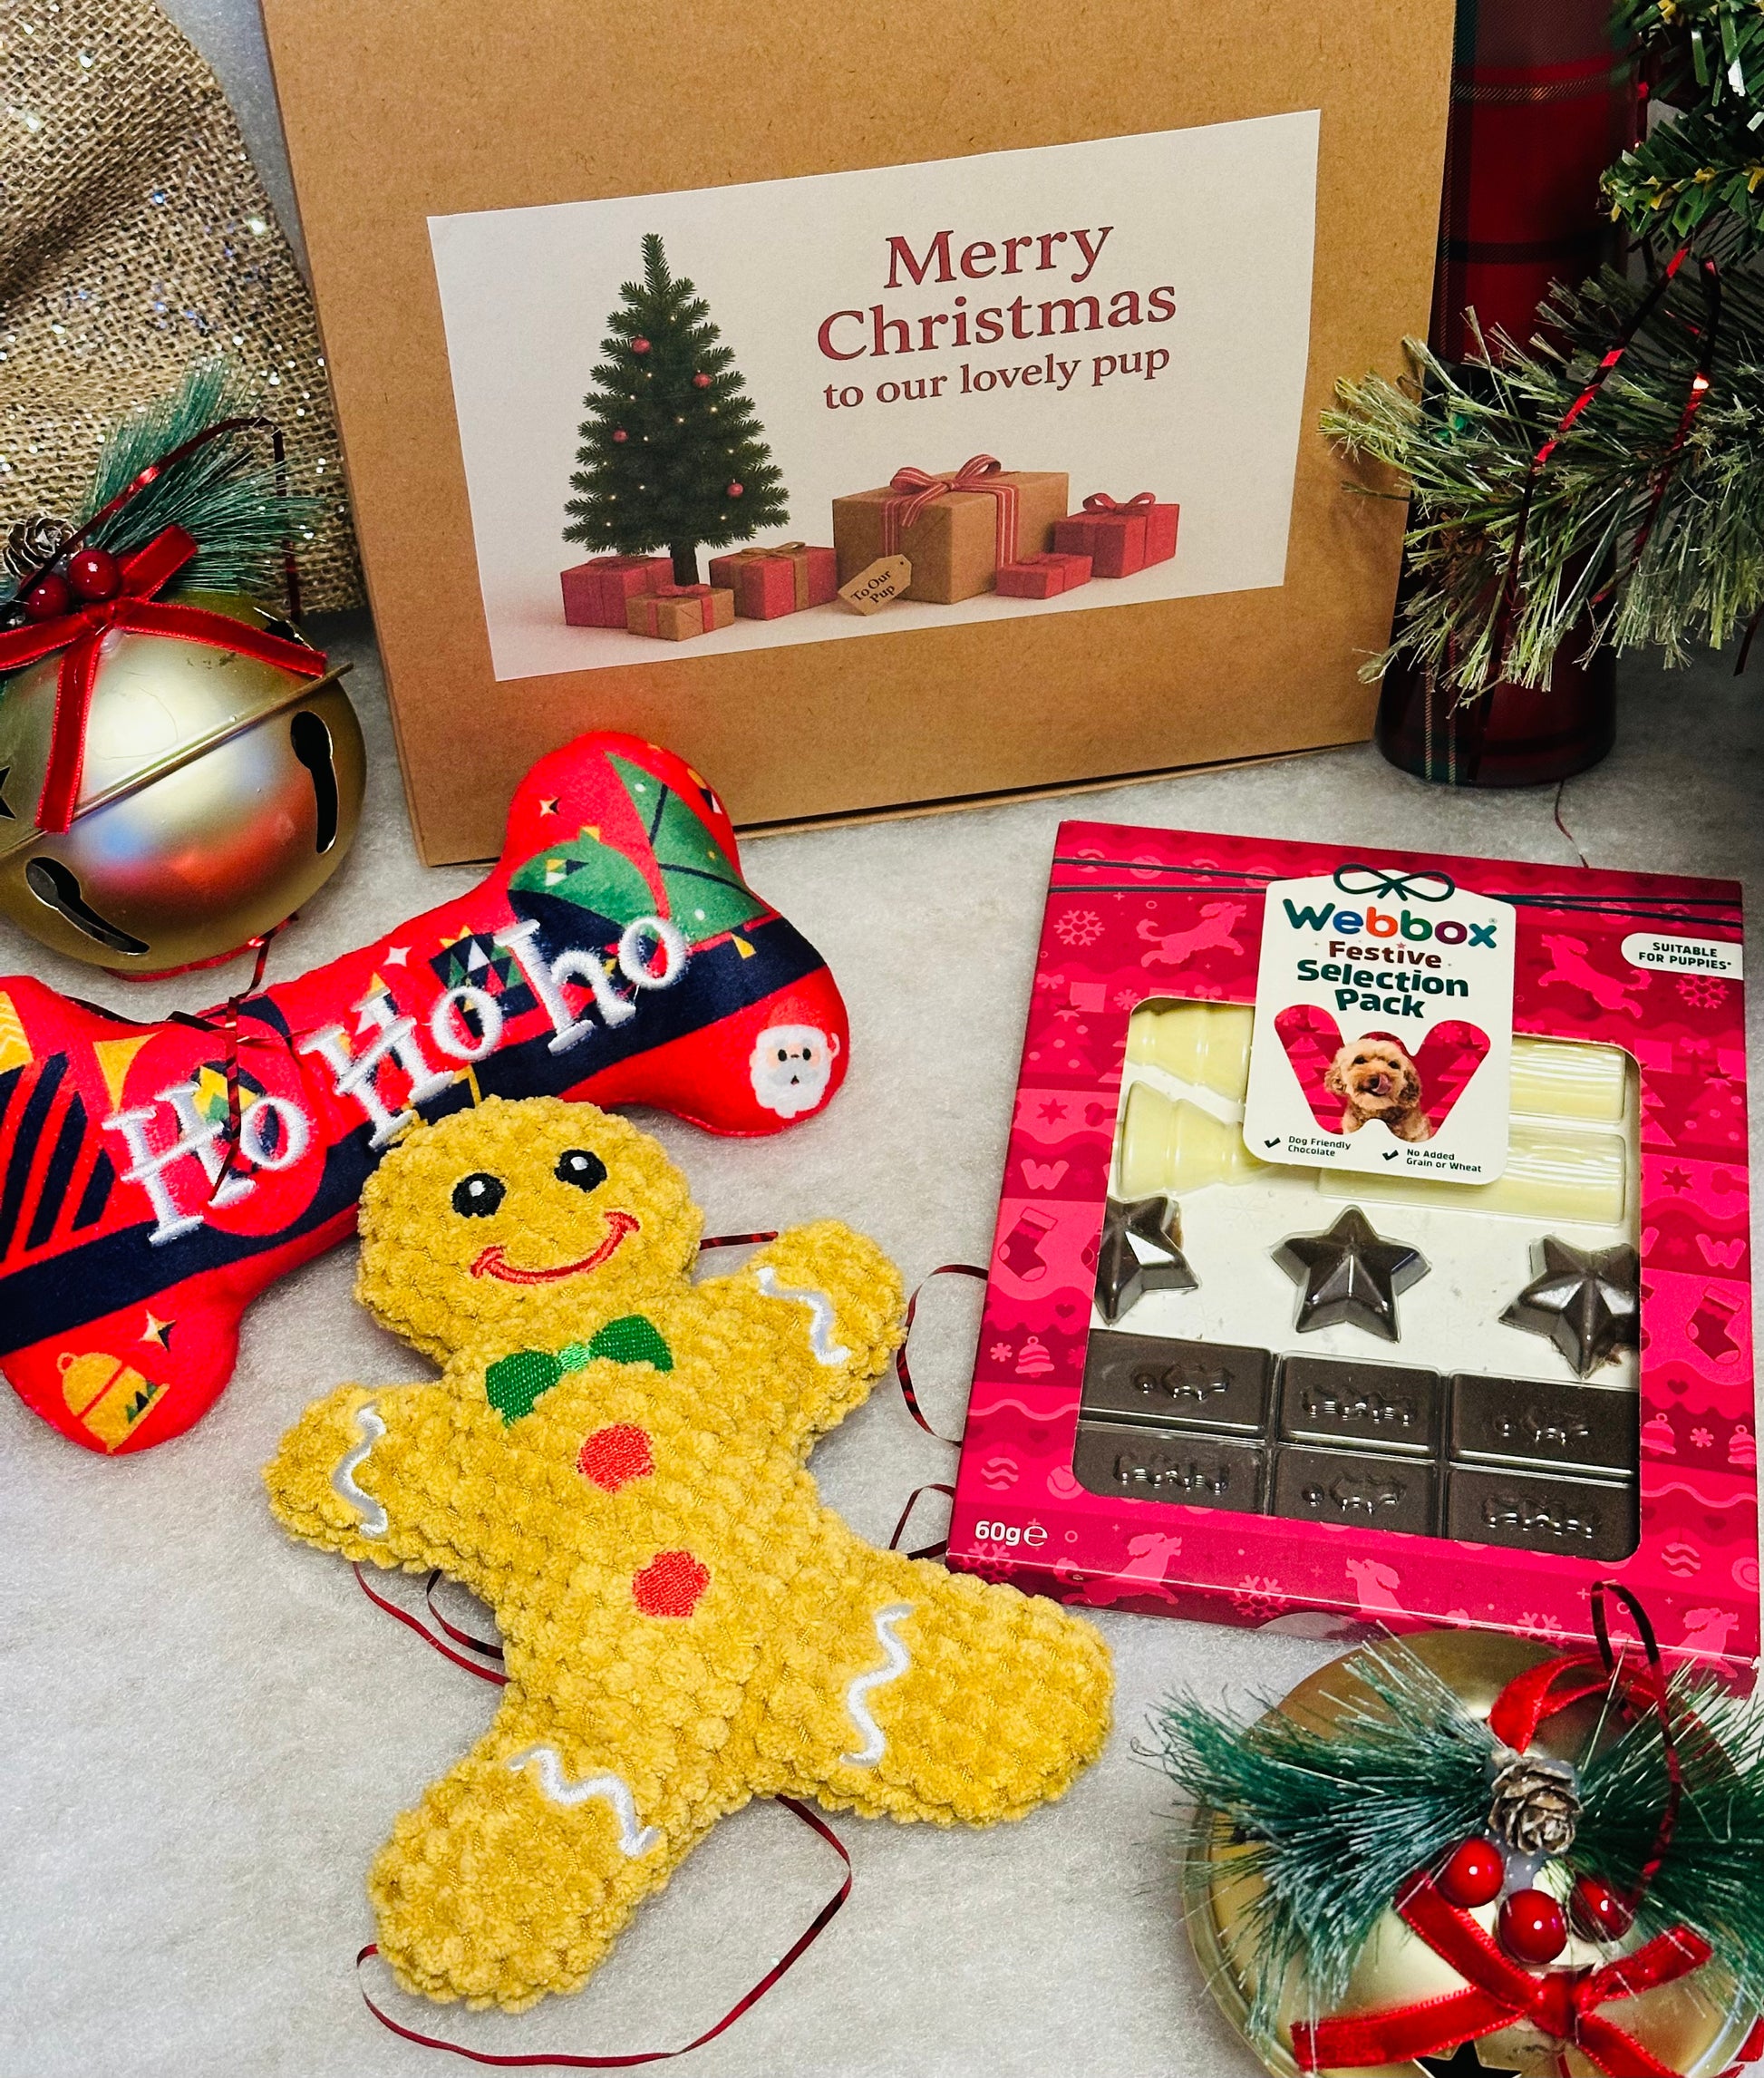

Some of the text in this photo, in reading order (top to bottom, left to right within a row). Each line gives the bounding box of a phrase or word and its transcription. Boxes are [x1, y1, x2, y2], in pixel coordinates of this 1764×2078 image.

[884, 226, 1114, 288] Merry
[818, 286, 1176, 360] Christmas
[824, 347, 1170, 409] to our lovely pup
[850, 570, 891, 601] To Our
[869, 585, 895, 603] Pup
[1329, 940, 1442, 969] Festive
[1639, 952, 1664, 963] FOR
[1653, 942, 1718, 958] SUITABLE
[1297, 959, 1469, 997] Selection
[1334, 989, 1426, 1019] Pack
[102, 1082, 309, 1246] Ho
[300, 986, 503, 1151] Ho
[1288, 1136, 1352, 1151] Dog Friendly
[1288, 1145, 1336, 1157] Chocolate
[1407, 1149, 1455, 1160] No Added
[1406, 1158, 1433, 1168] Grain
[1449, 1162, 1482, 1173] Wheat
